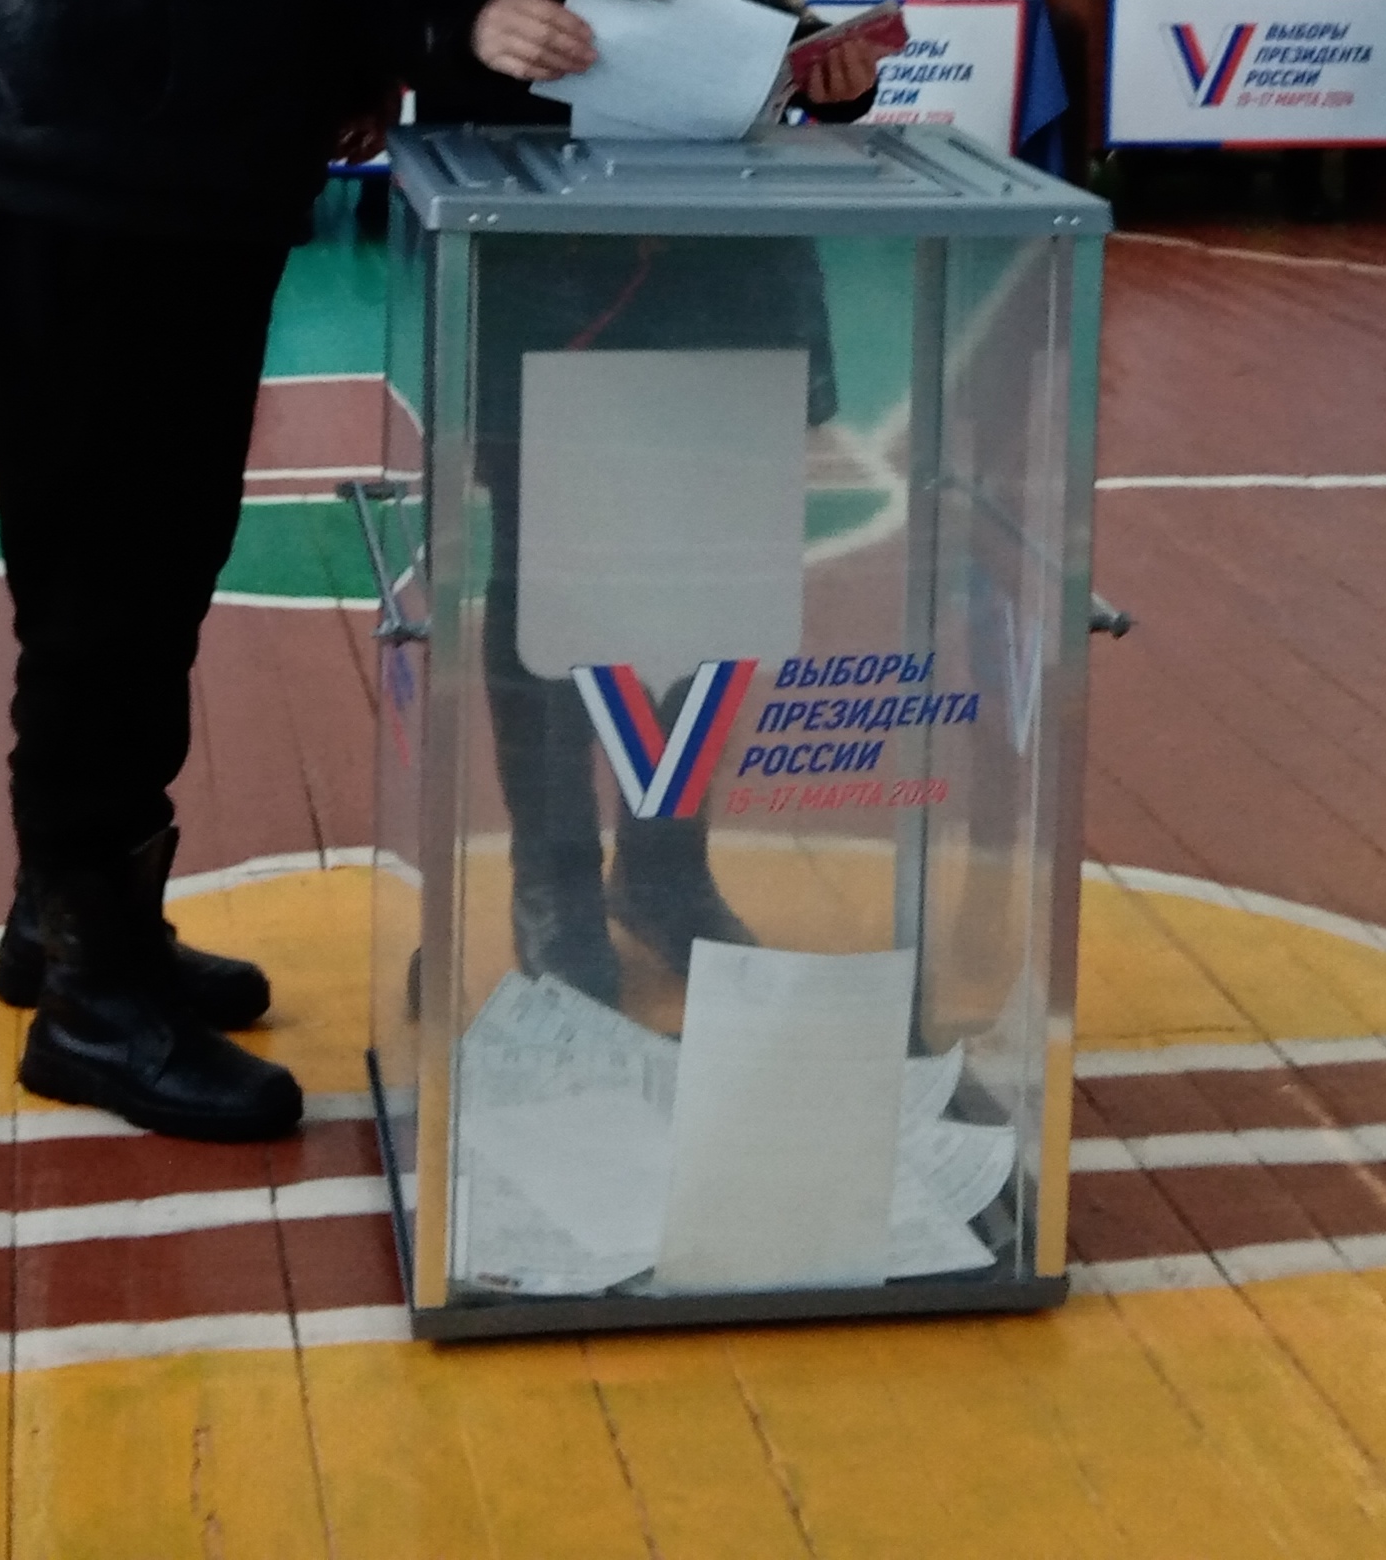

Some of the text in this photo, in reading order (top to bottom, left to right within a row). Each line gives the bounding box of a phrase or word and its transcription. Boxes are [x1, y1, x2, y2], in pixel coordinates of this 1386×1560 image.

[1264, 22, 1351, 41] ВЫБОРЫ
[896, 40, 950, 58] ОРЫ
[1253, 44, 1373, 65] ПРЕЗИДЕНТА
[878, 63, 974, 84] ЕЗИДЕНТА
[1244, 68, 1323, 87] РОССИИ
[877, 88, 921, 106] СИИ
[773, 652, 936, 690] ВЫБОРЫ
[756, 692, 981, 734] ПРЕЗИДЕНТА
[737, 740, 885, 778] РОССИИ
[799, 780, 883, 810] МАРТА
[888, 778, 950, 808] 2024
